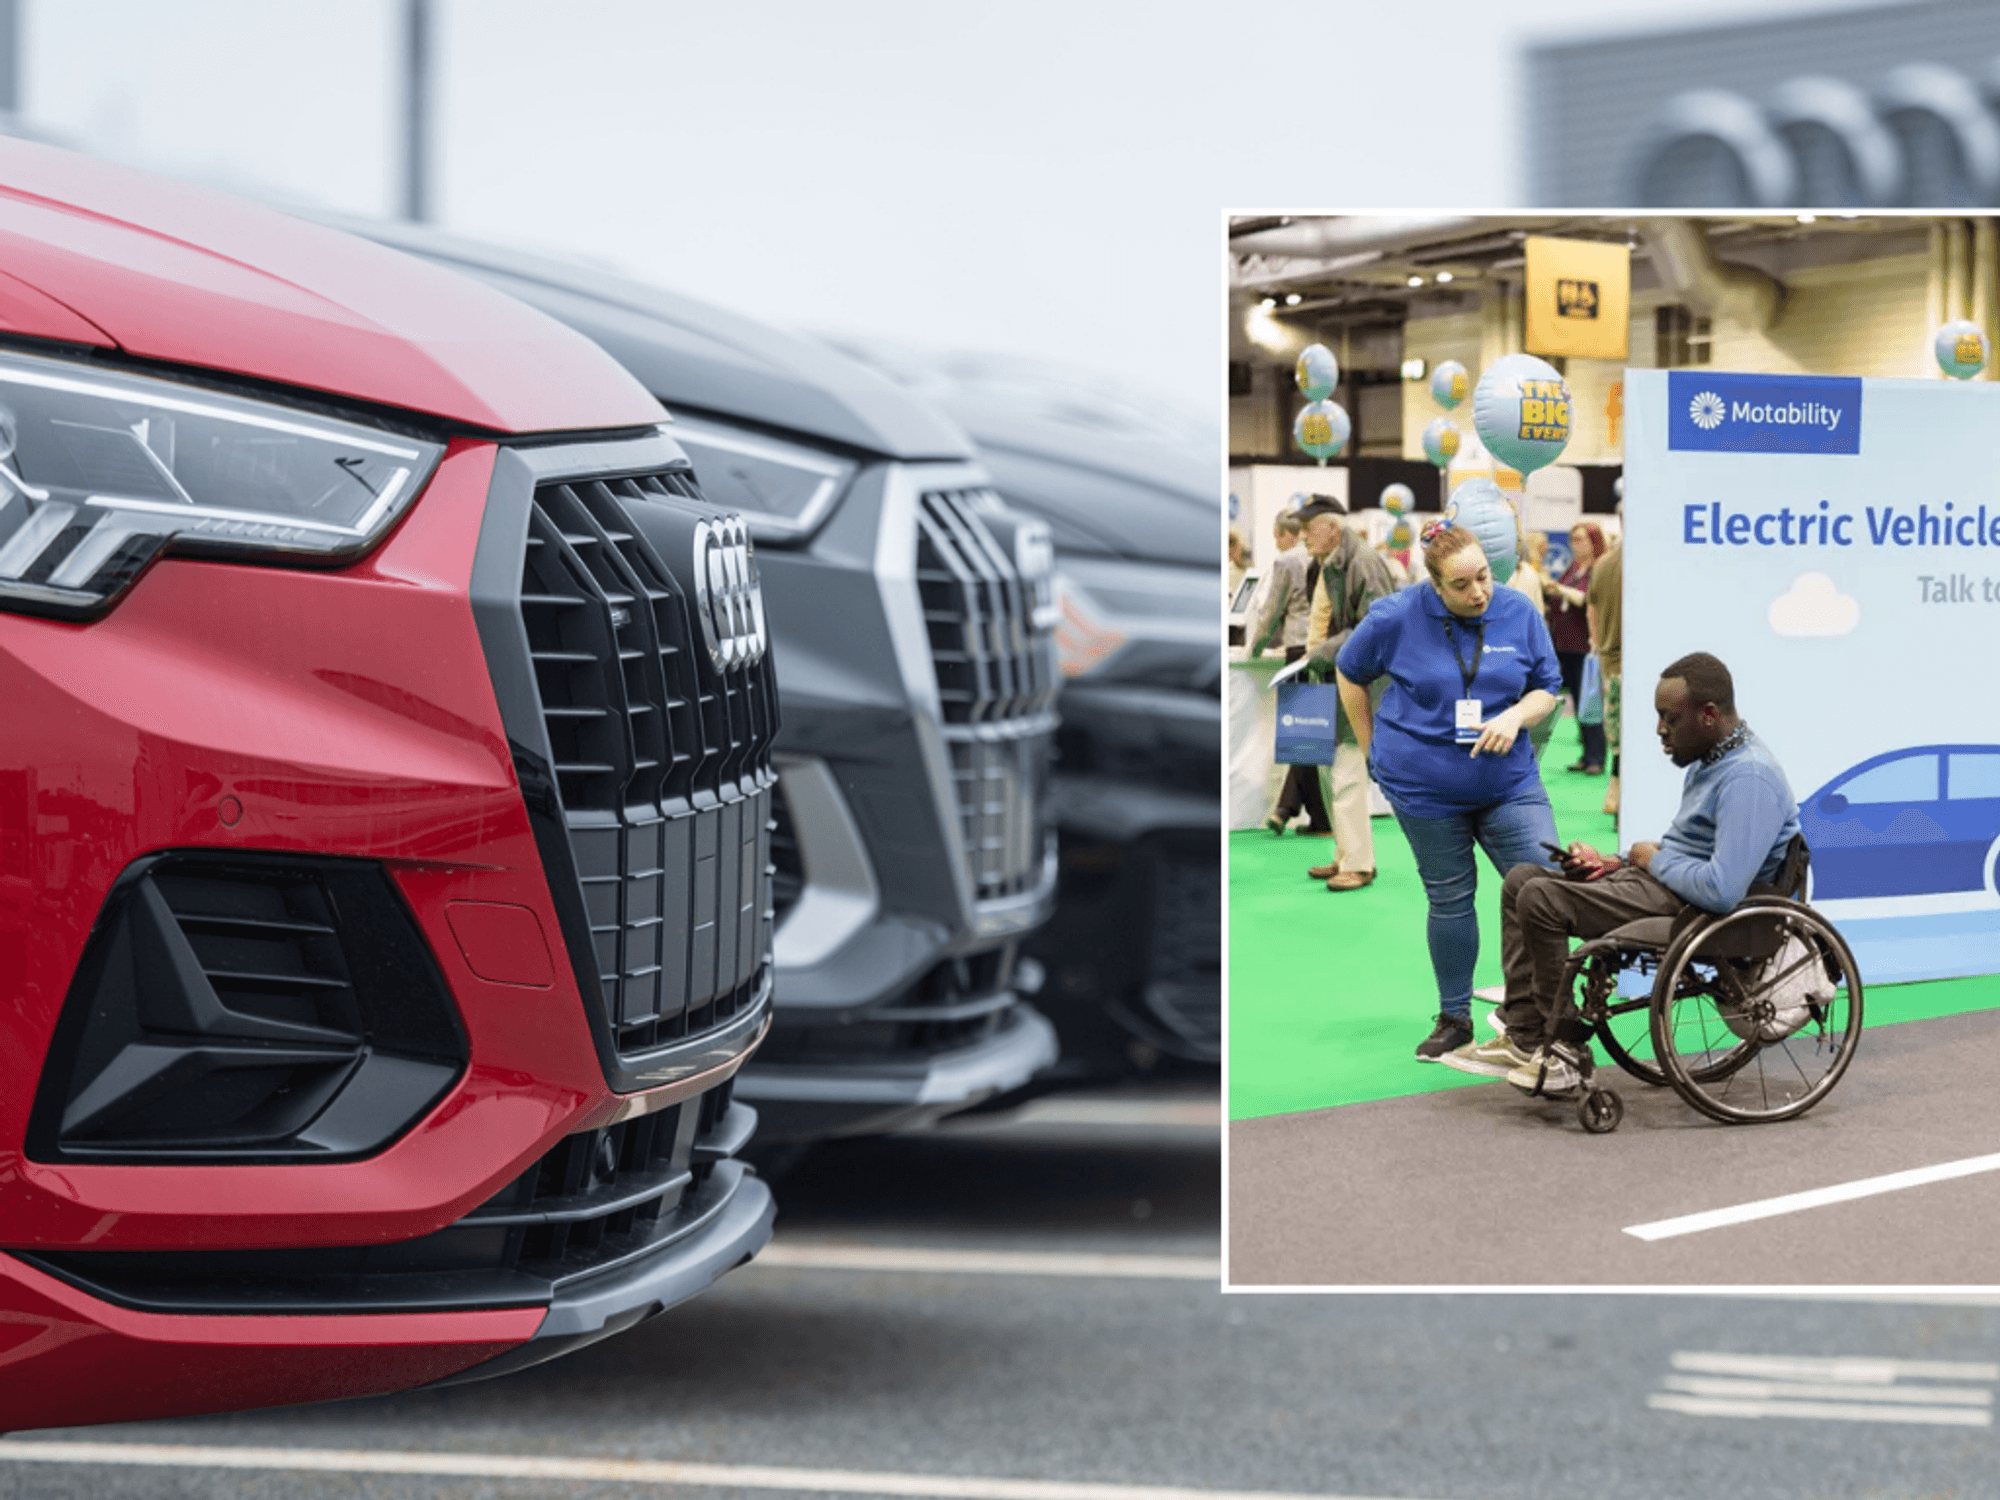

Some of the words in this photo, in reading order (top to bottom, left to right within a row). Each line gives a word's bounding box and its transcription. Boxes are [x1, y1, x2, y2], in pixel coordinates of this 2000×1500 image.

[1521, 399, 1568, 425] BIG
[1732, 401, 1842, 431] Motability
[1684, 500, 1853, 545] Electric
[1917, 574, 1975, 604] Talk
